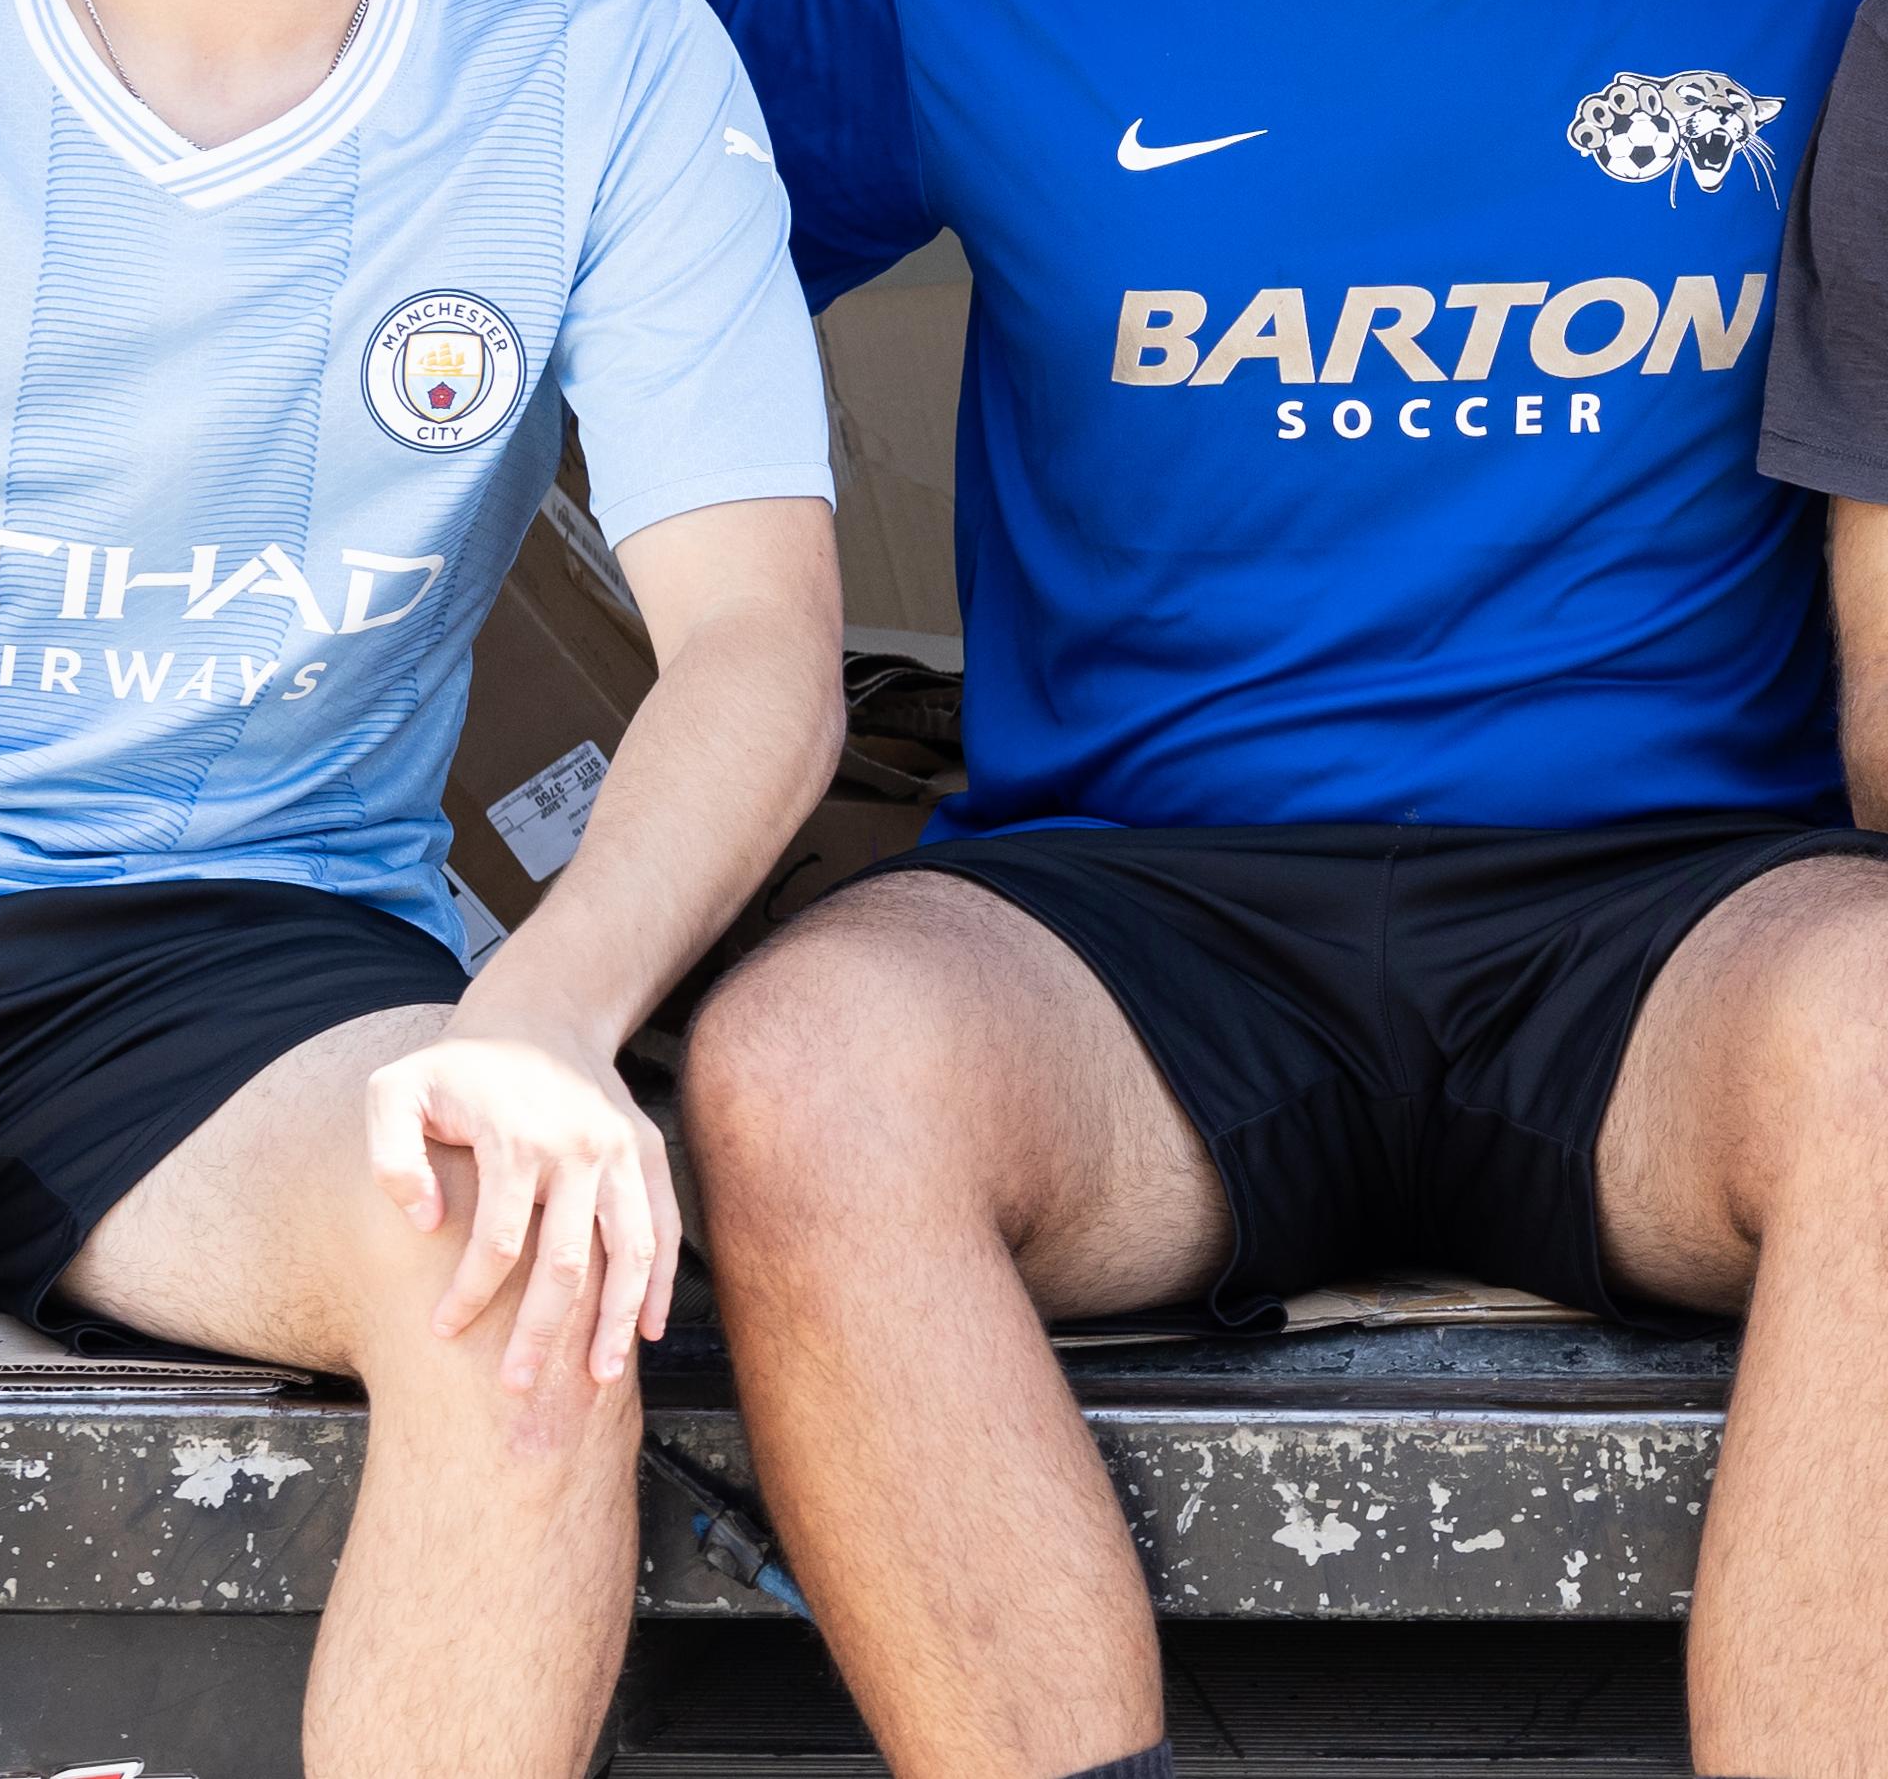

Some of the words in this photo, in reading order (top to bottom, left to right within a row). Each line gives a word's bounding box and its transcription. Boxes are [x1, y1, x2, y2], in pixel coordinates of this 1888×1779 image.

[381, 302, 509, 354] MANCHESTER
[1111, 272, 1768, 387] BARTON
[416, 426, 464, 441] CITY
[1276, 392, 1602, 441] SOCCER
